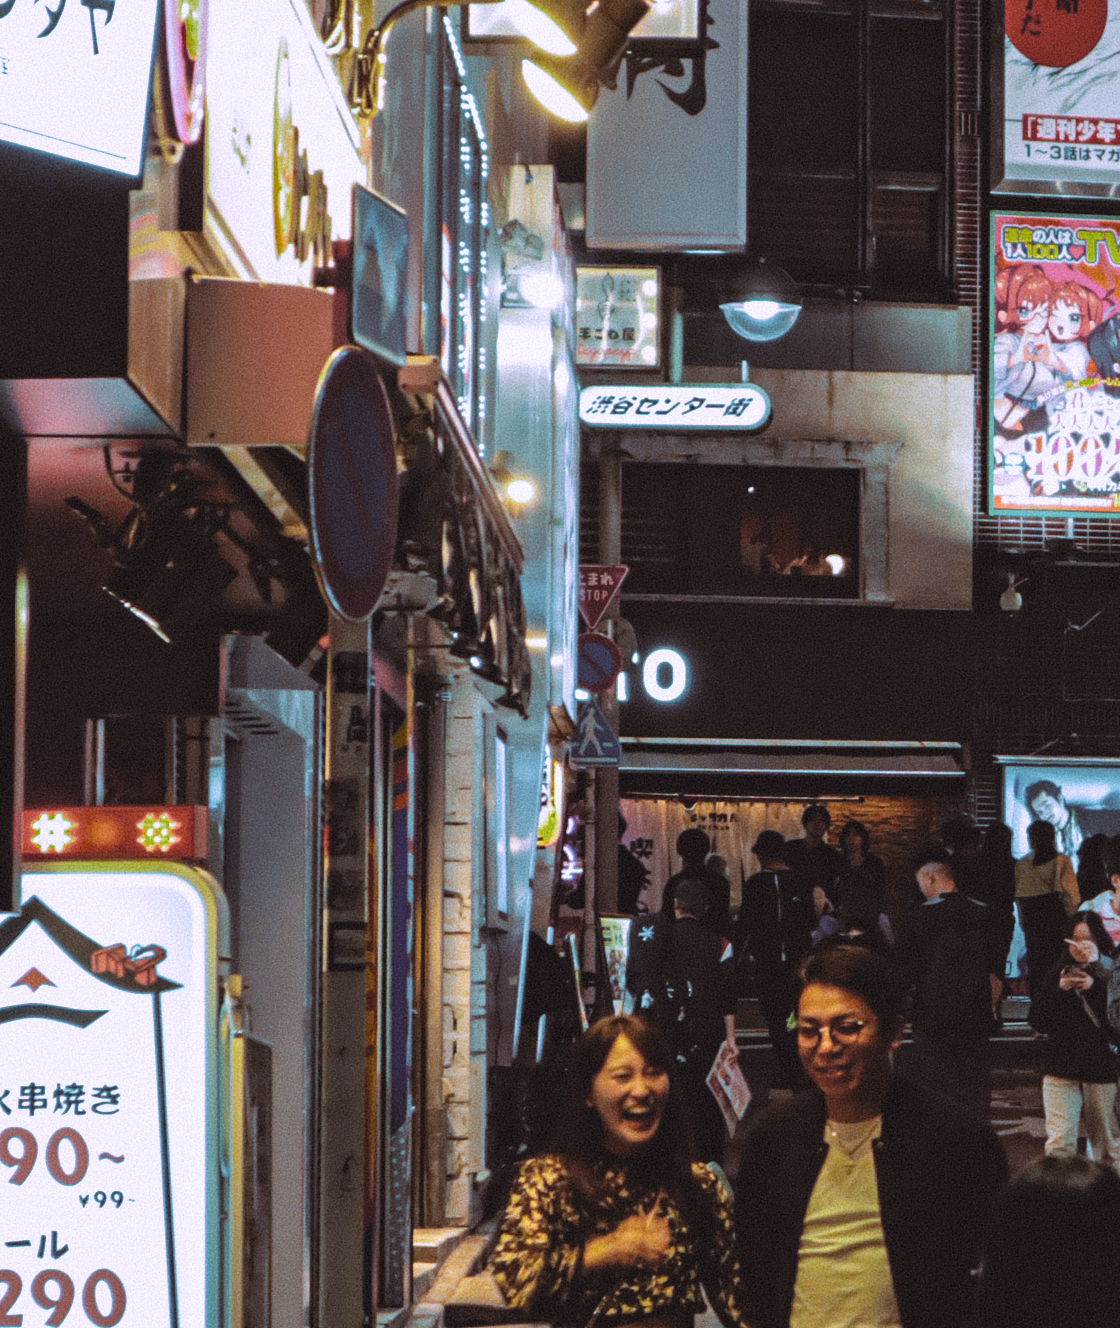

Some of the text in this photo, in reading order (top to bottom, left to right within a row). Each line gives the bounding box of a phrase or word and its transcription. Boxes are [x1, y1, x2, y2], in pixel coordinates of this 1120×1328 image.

[586, 395, 753, 418] 渋谷センター街
[579, 572, 615, 586] とまれ
[580, 590, 608, 601] STOP
